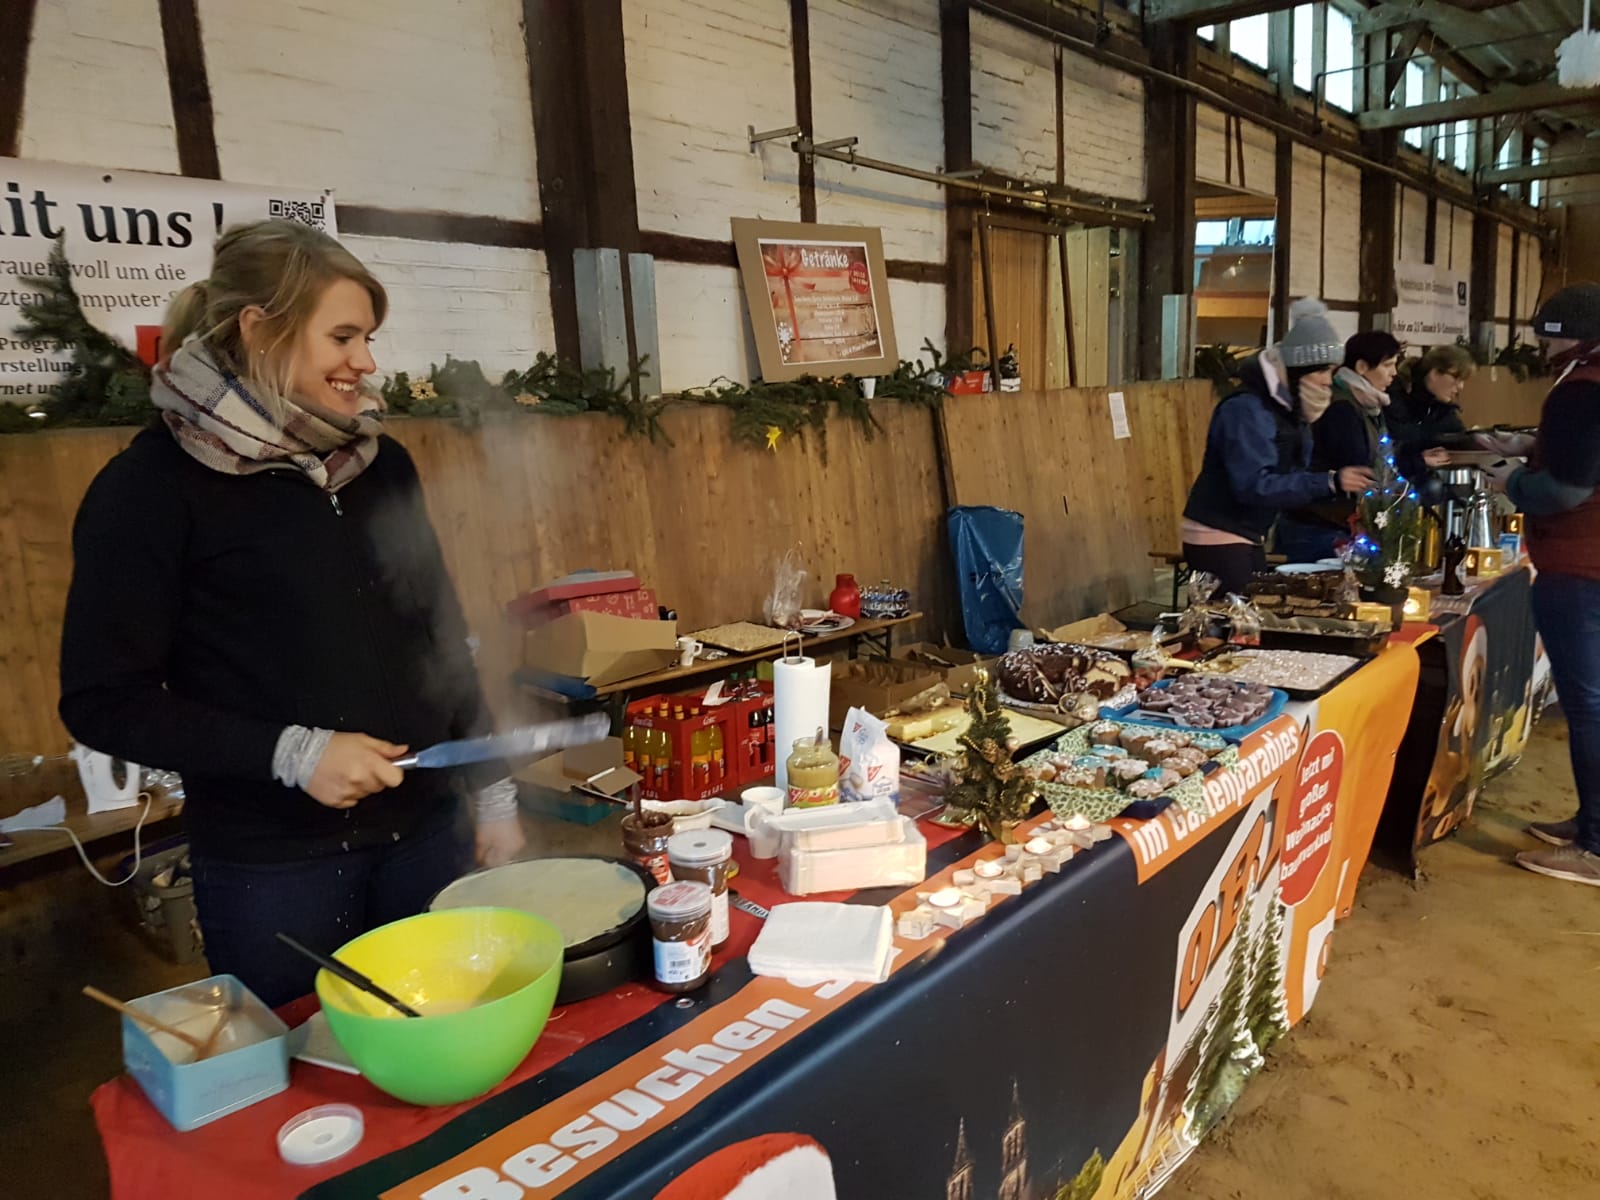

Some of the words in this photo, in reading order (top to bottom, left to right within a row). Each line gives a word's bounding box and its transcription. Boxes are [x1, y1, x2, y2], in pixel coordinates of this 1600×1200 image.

[0, 182, 60, 239] it
[77, 203, 192, 248] uns
[115, 266, 149, 280] um
[155, 264, 187, 281] die
[801, 248, 849, 269] Getränke
[81, 290, 177, 313] mputer-
[1123, 820, 1170, 865] im
[1163, 724, 1299, 841] Gatenparadies
[419, 998, 811, 1200] Besuchen
